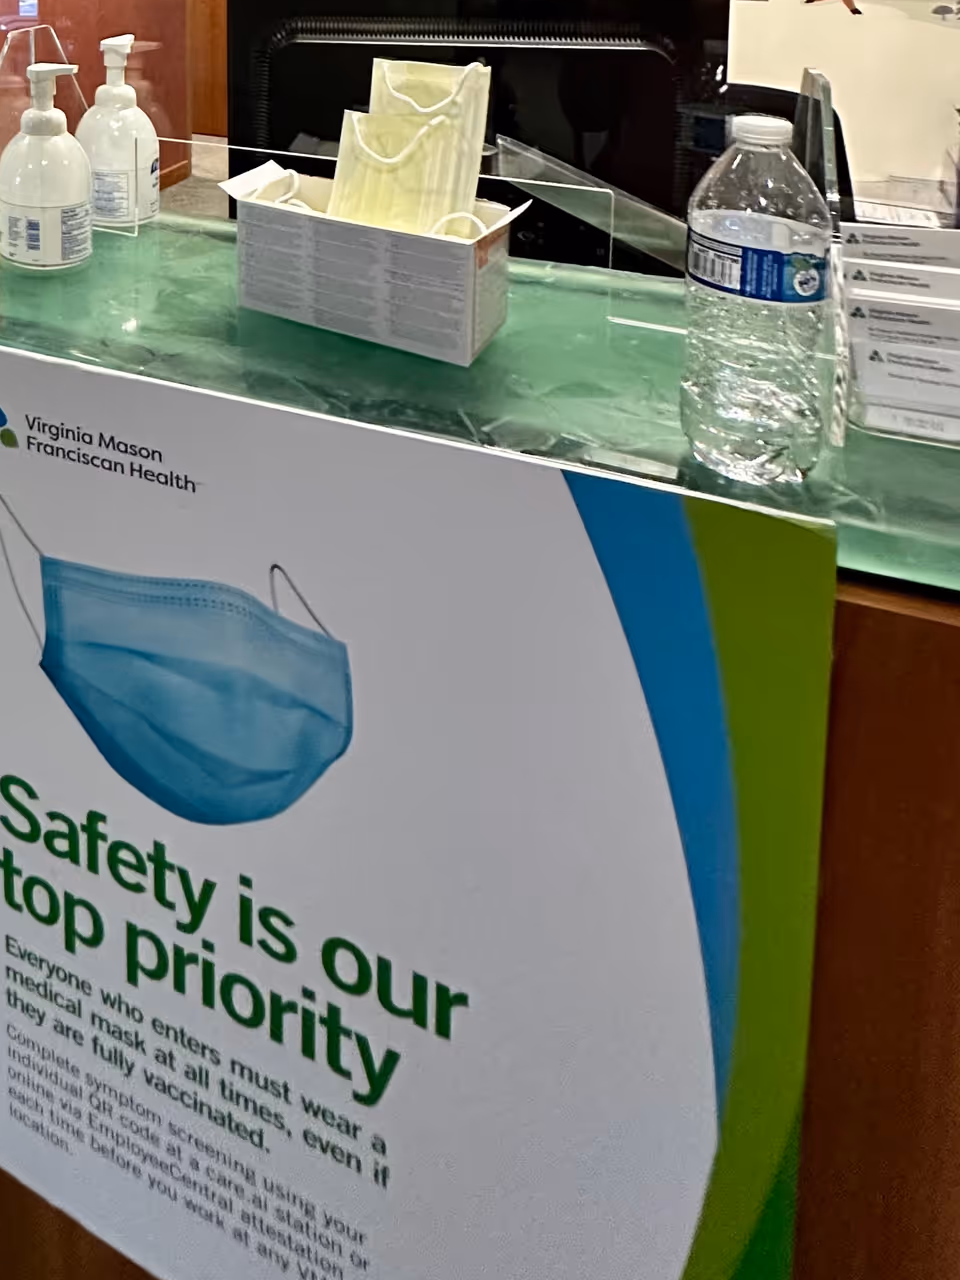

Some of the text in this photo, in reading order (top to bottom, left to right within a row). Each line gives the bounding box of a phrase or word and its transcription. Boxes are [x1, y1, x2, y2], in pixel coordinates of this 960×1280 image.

[25, 414, 163, 463] Virginia Mason
[26, 435, 197, 493] Franciscan Health
[5, 934, 387, 1156] Everyone who enters must wear a
[126, 920, 402, 1108] priority
[238, 874, 297, 964] is
[321, 936, 470, 1041] our
[5, 965, 390, 1188] medical mask at all times, even if
[6, 988, 271, 1154] they are fully vaccinated.
[6, 1023, 367, 1245] Complete symptom screening using your
[8, 1045, 83, 1098] individual
[89, 1092, 113, 1119] QR
[120, 1114, 160, 1144] code
[166, 1143, 182, 1162] at
[189, 1156, 200, 1171] a
[275, 1206, 343, 1257] station
[350, 1250, 370, 1271] or
[9, 1102, 74, 1156] location.
[7, 1066, 55, 1103] online
[59, 1098, 82, 1120] via
[88, 1111, 233, 1214] EmployeeCentral
[240, 1209, 344, 1280] attestation
[8, 1086, 44, 1116] each
[50, 1107, 86, 1144] time
[90, 1134, 143, 1180] before
[147, 1172, 178, 1202] you
[183, 1195, 226, 1230] work
[231, 1226, 249, 1247] at
[257, 1241, 290, 1273] any
